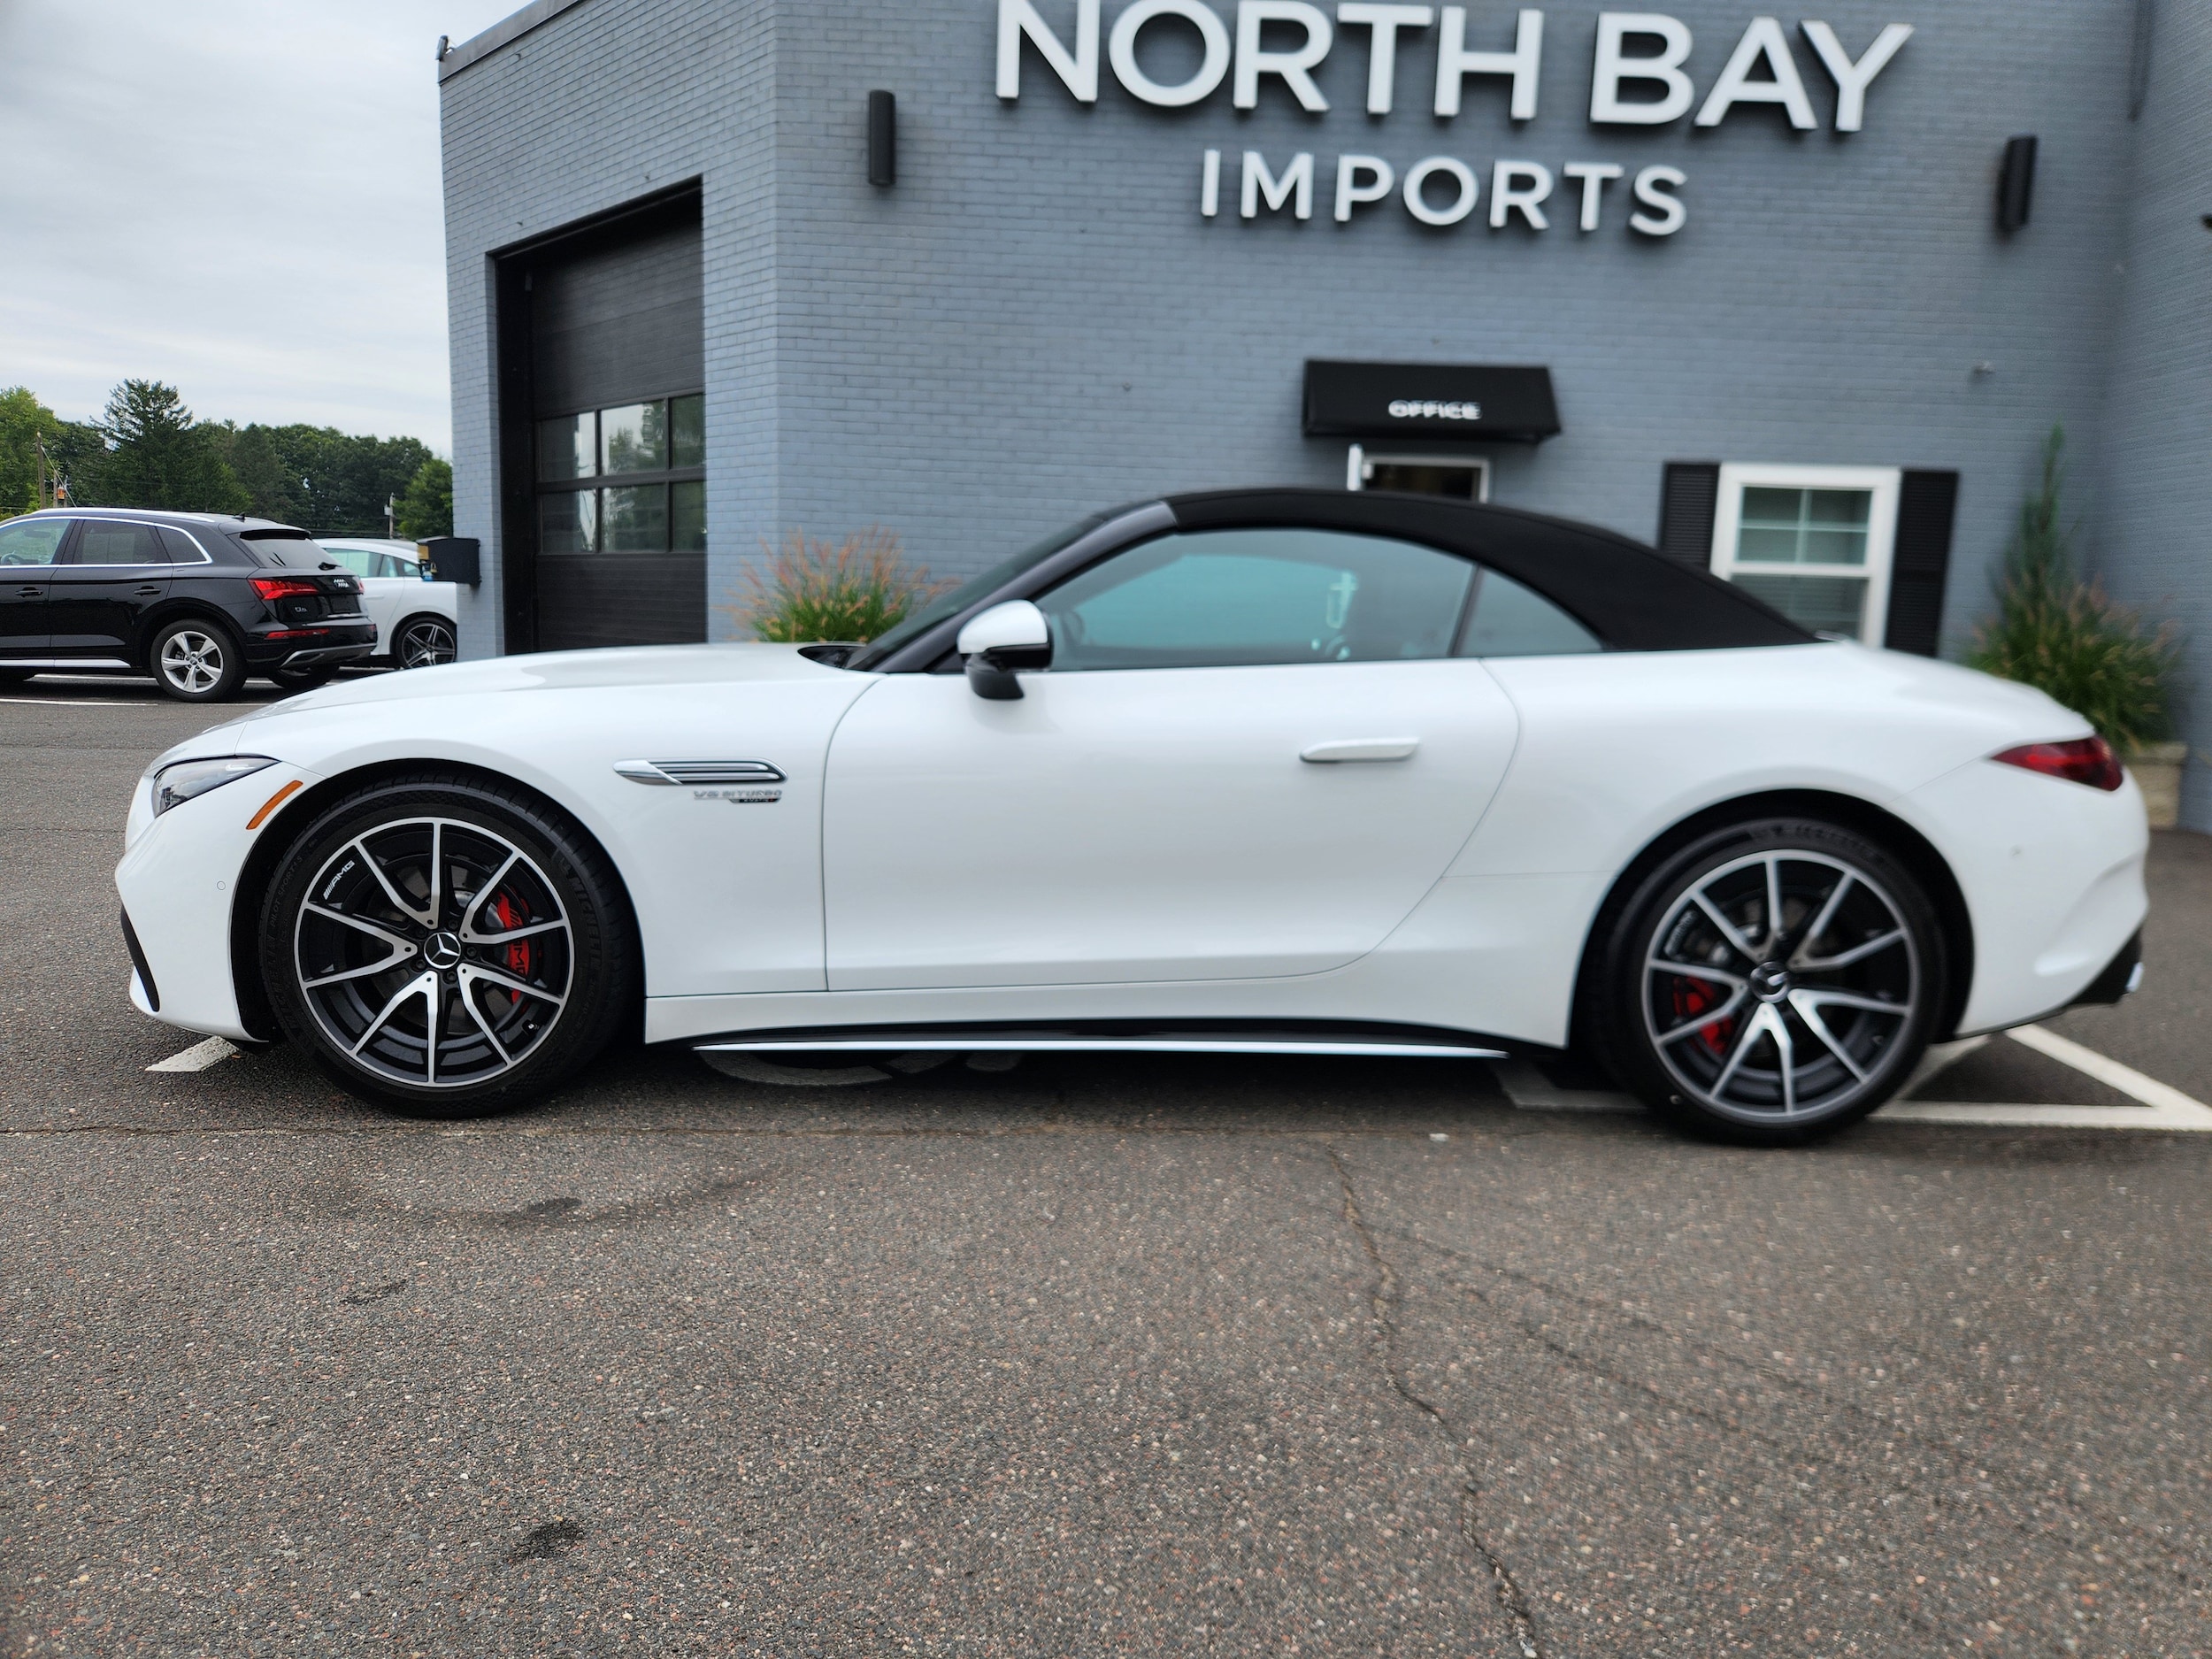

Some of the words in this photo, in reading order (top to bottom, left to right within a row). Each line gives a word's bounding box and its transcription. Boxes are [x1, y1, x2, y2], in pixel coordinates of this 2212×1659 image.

[995, 0, 1543, 120] NORTH
[1590, 11, 1915, 133] BAY
[1201, 148, 1689, 237] IMPORTS
[1388, 399, 1483, 420] OFFICE
